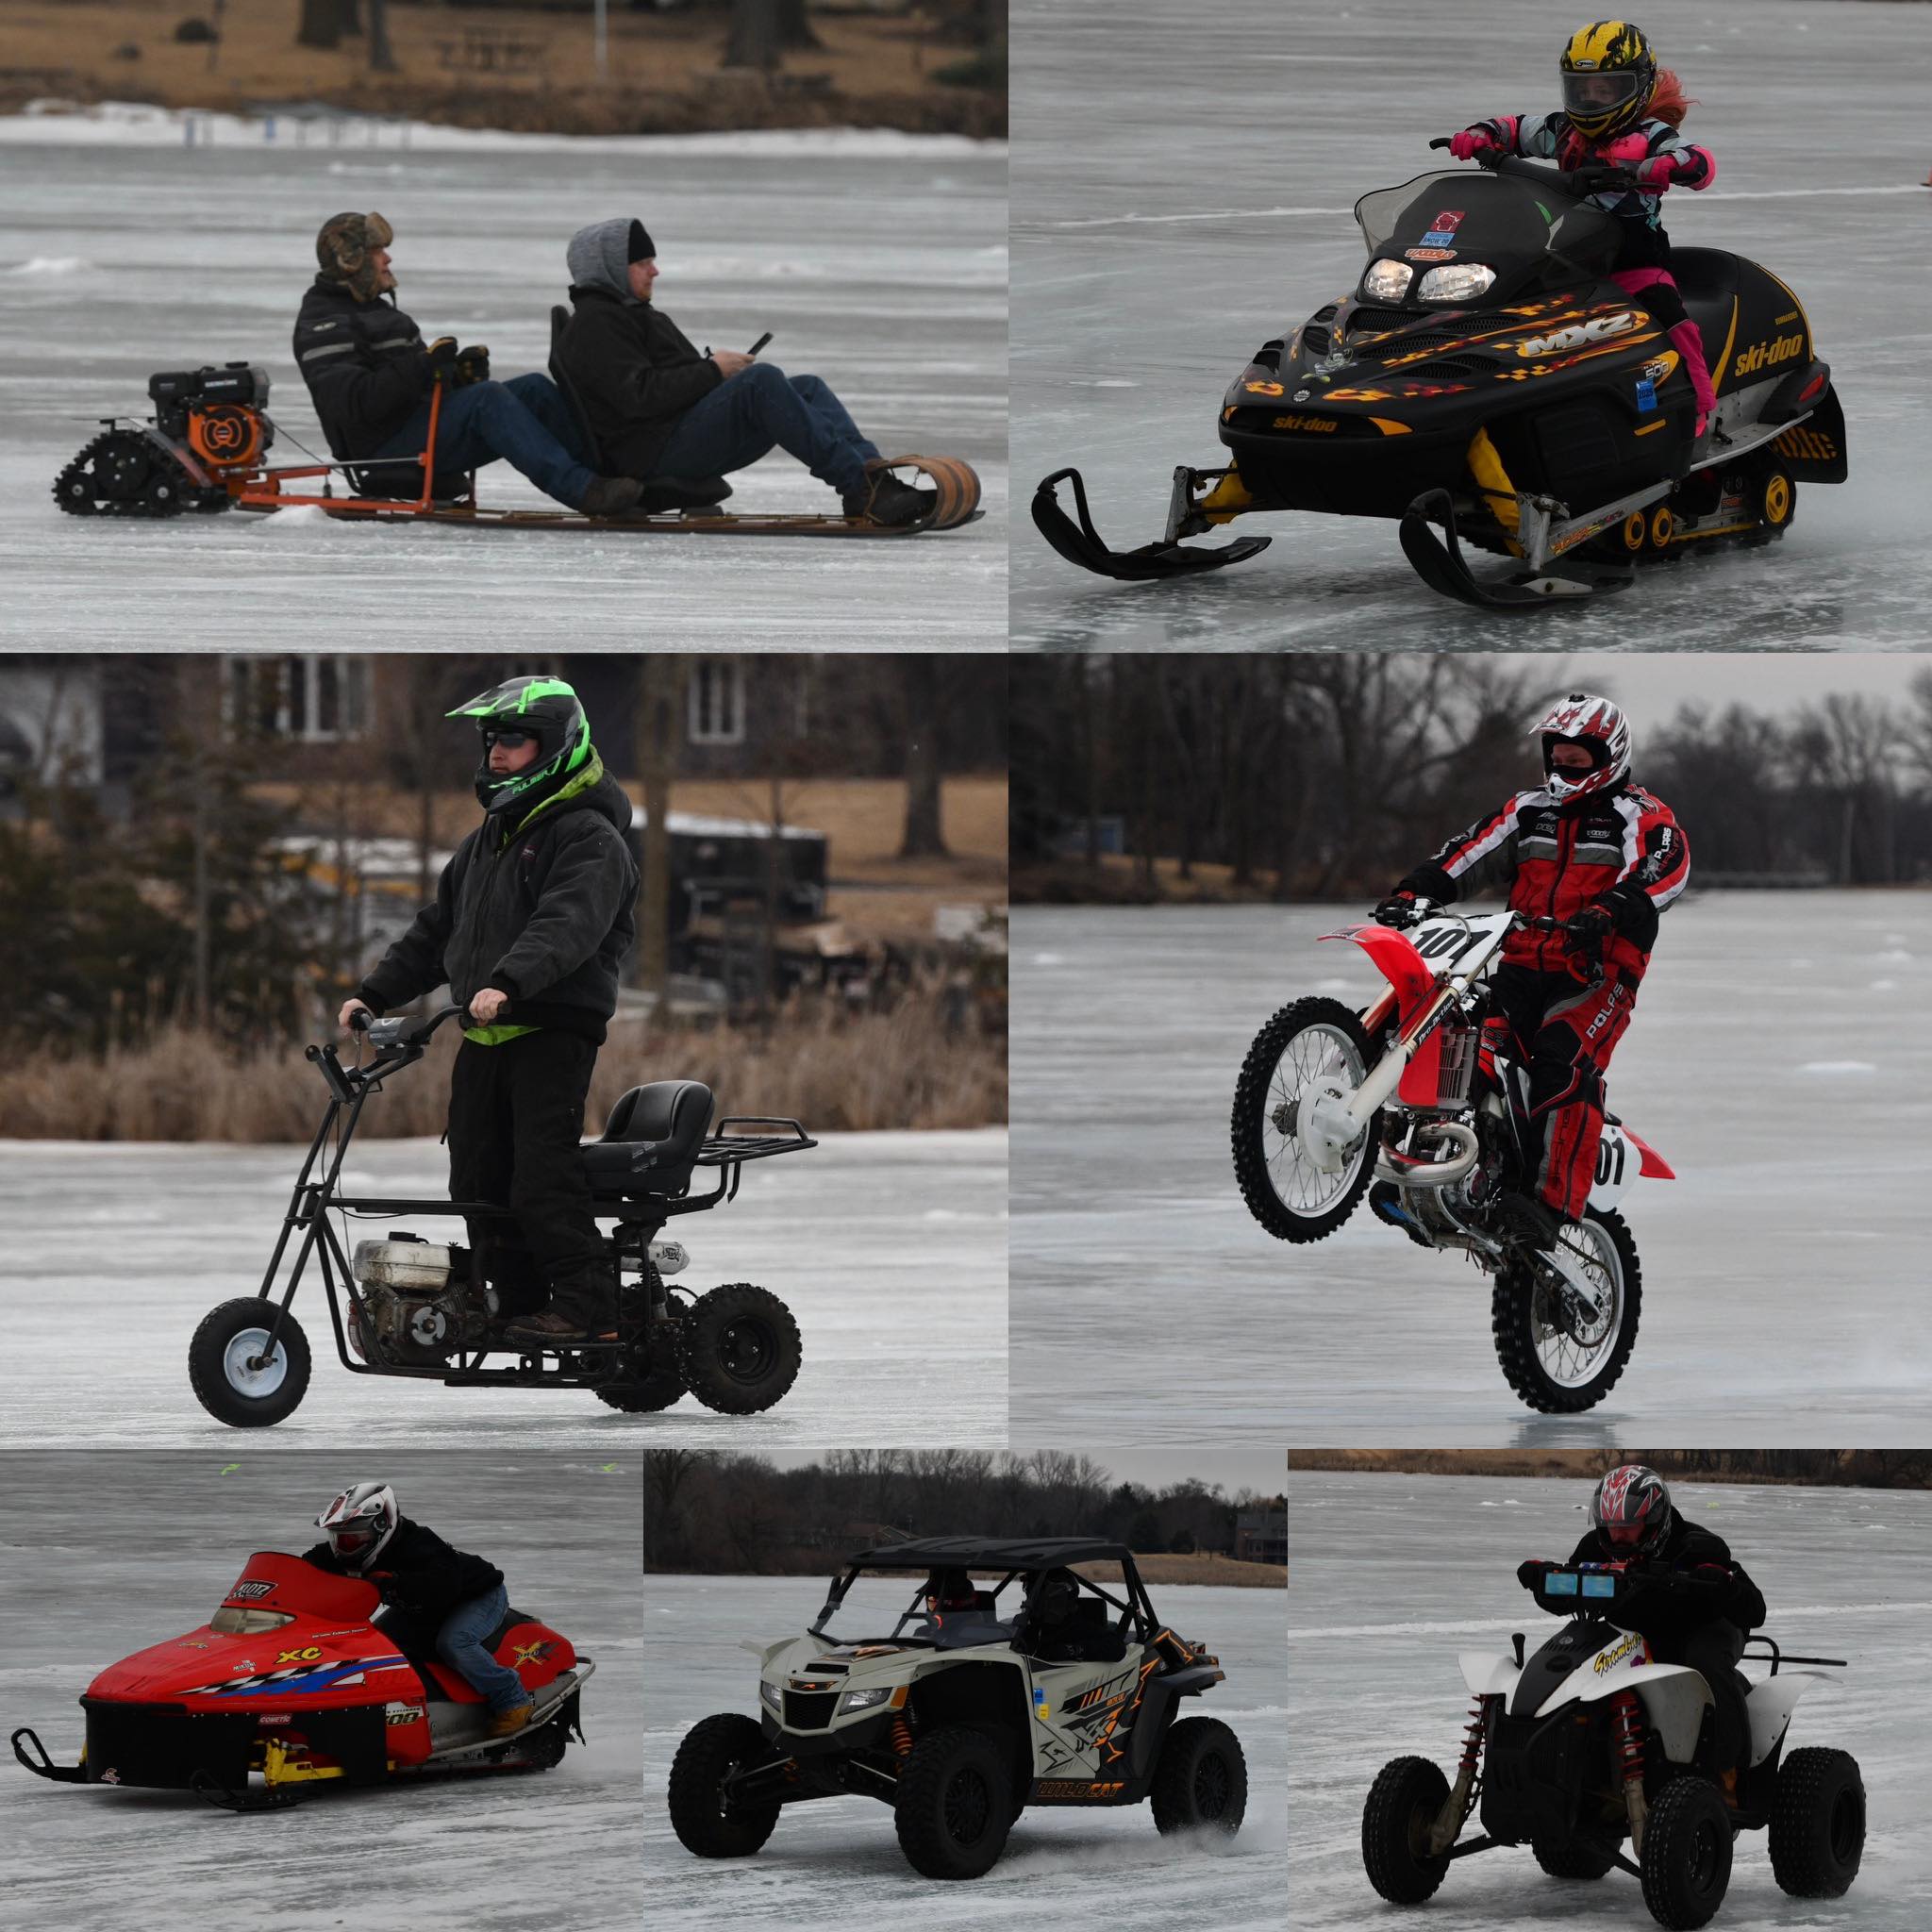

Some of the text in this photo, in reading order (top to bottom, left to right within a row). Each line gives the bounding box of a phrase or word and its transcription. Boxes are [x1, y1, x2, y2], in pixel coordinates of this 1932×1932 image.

[1525, 313, 1632, 356] MXZ
[1735, 333, 1804, 377] ski-doo
[1414, 926, 1493, 969] 101
[1594, 1137, 1624, 1186] 01
[237, 1582, 271, 1596] KLOTZ
[275, 1647, 322, 1664] XC
